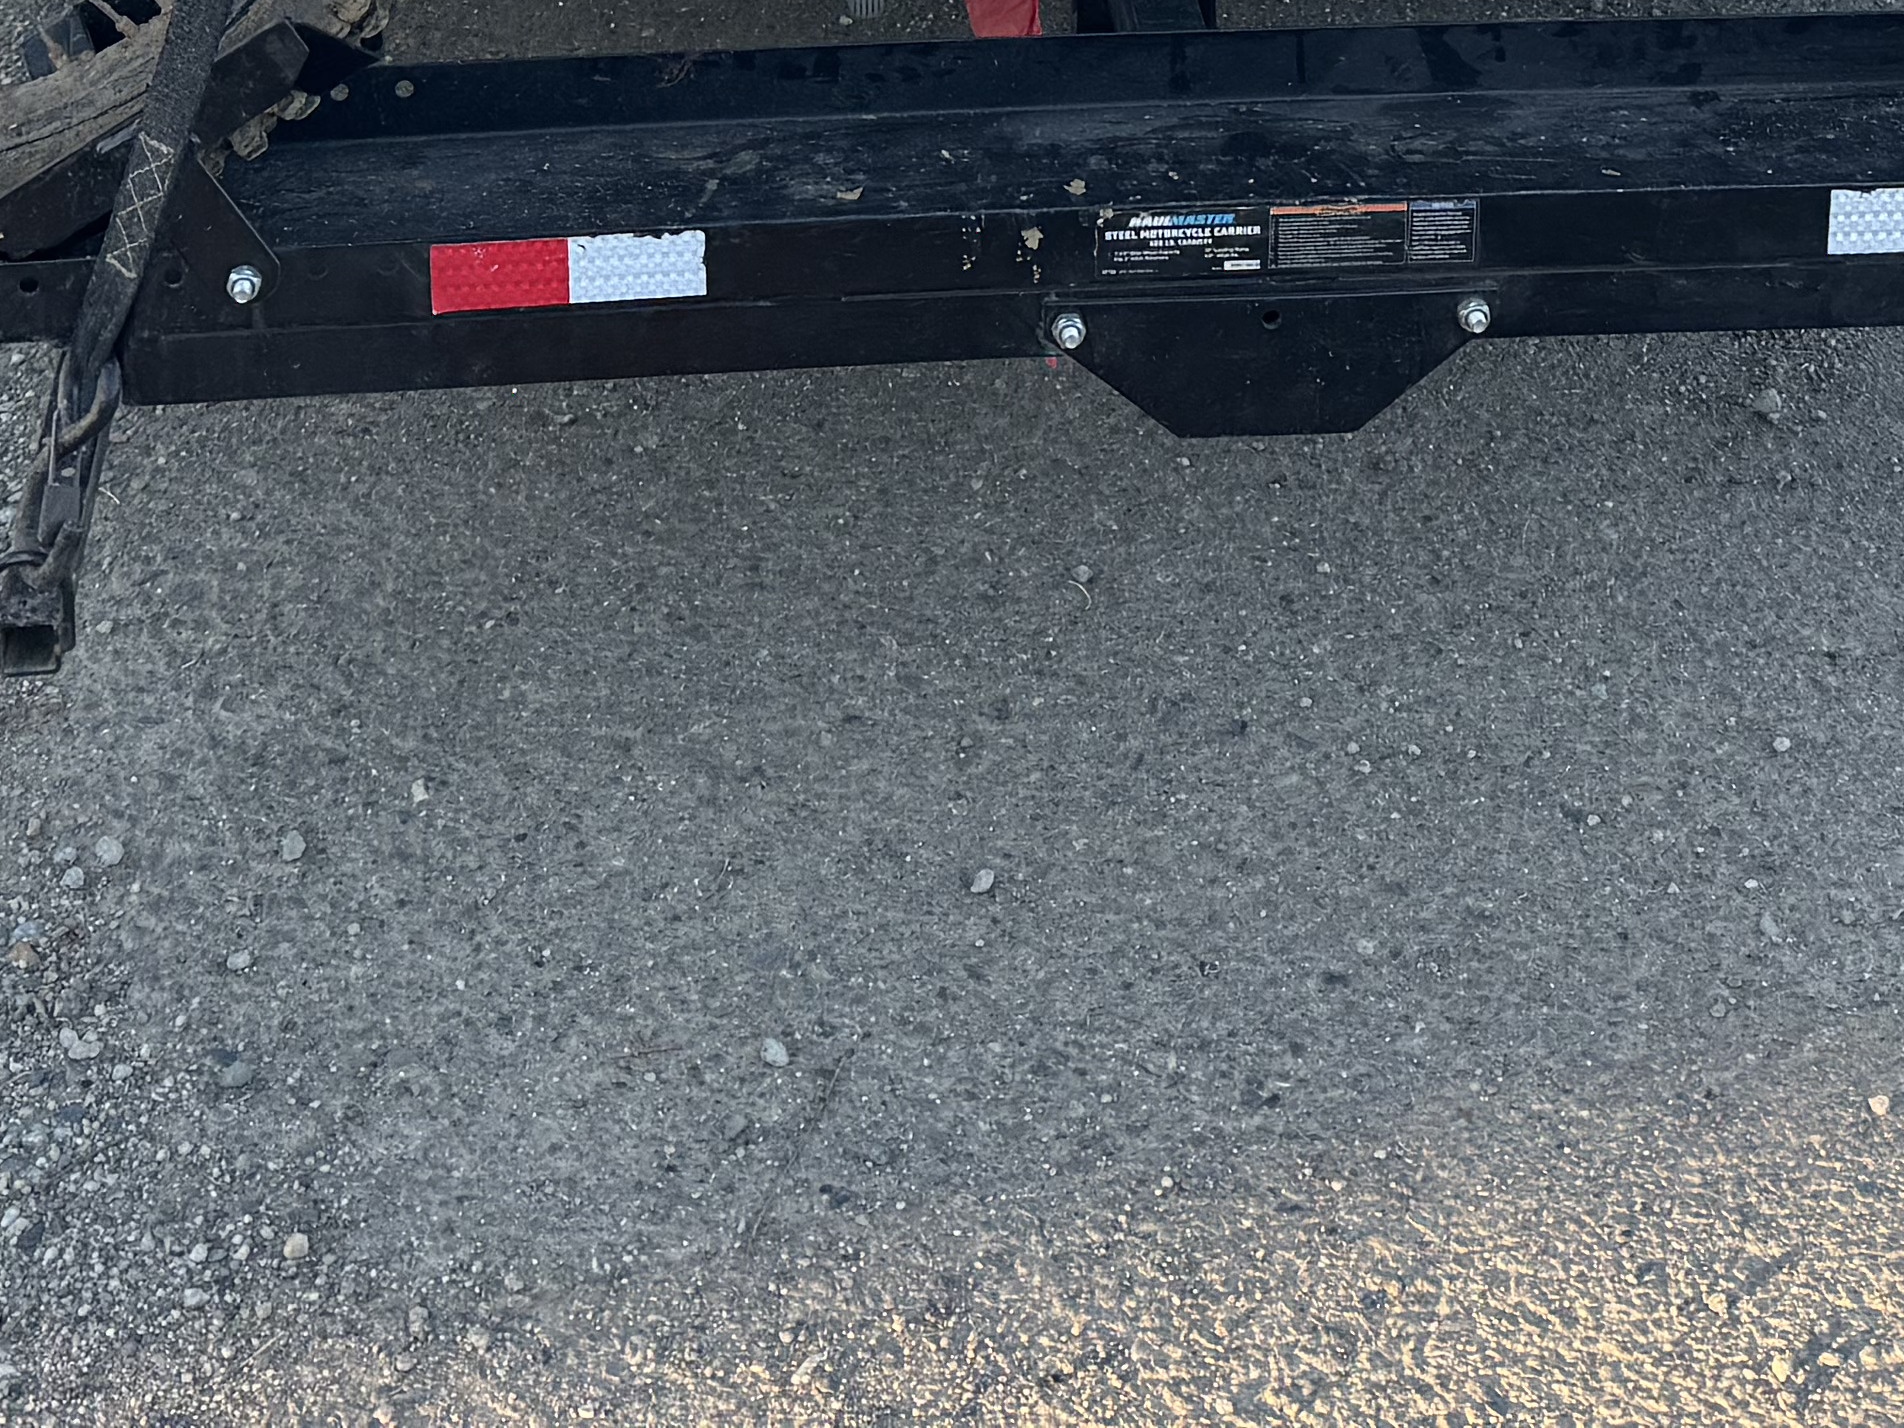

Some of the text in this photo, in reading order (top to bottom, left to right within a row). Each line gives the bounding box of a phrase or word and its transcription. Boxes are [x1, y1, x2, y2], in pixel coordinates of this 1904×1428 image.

[1104, 225, 1262, 241] STEEL MOTORCYCLE CARRIER
